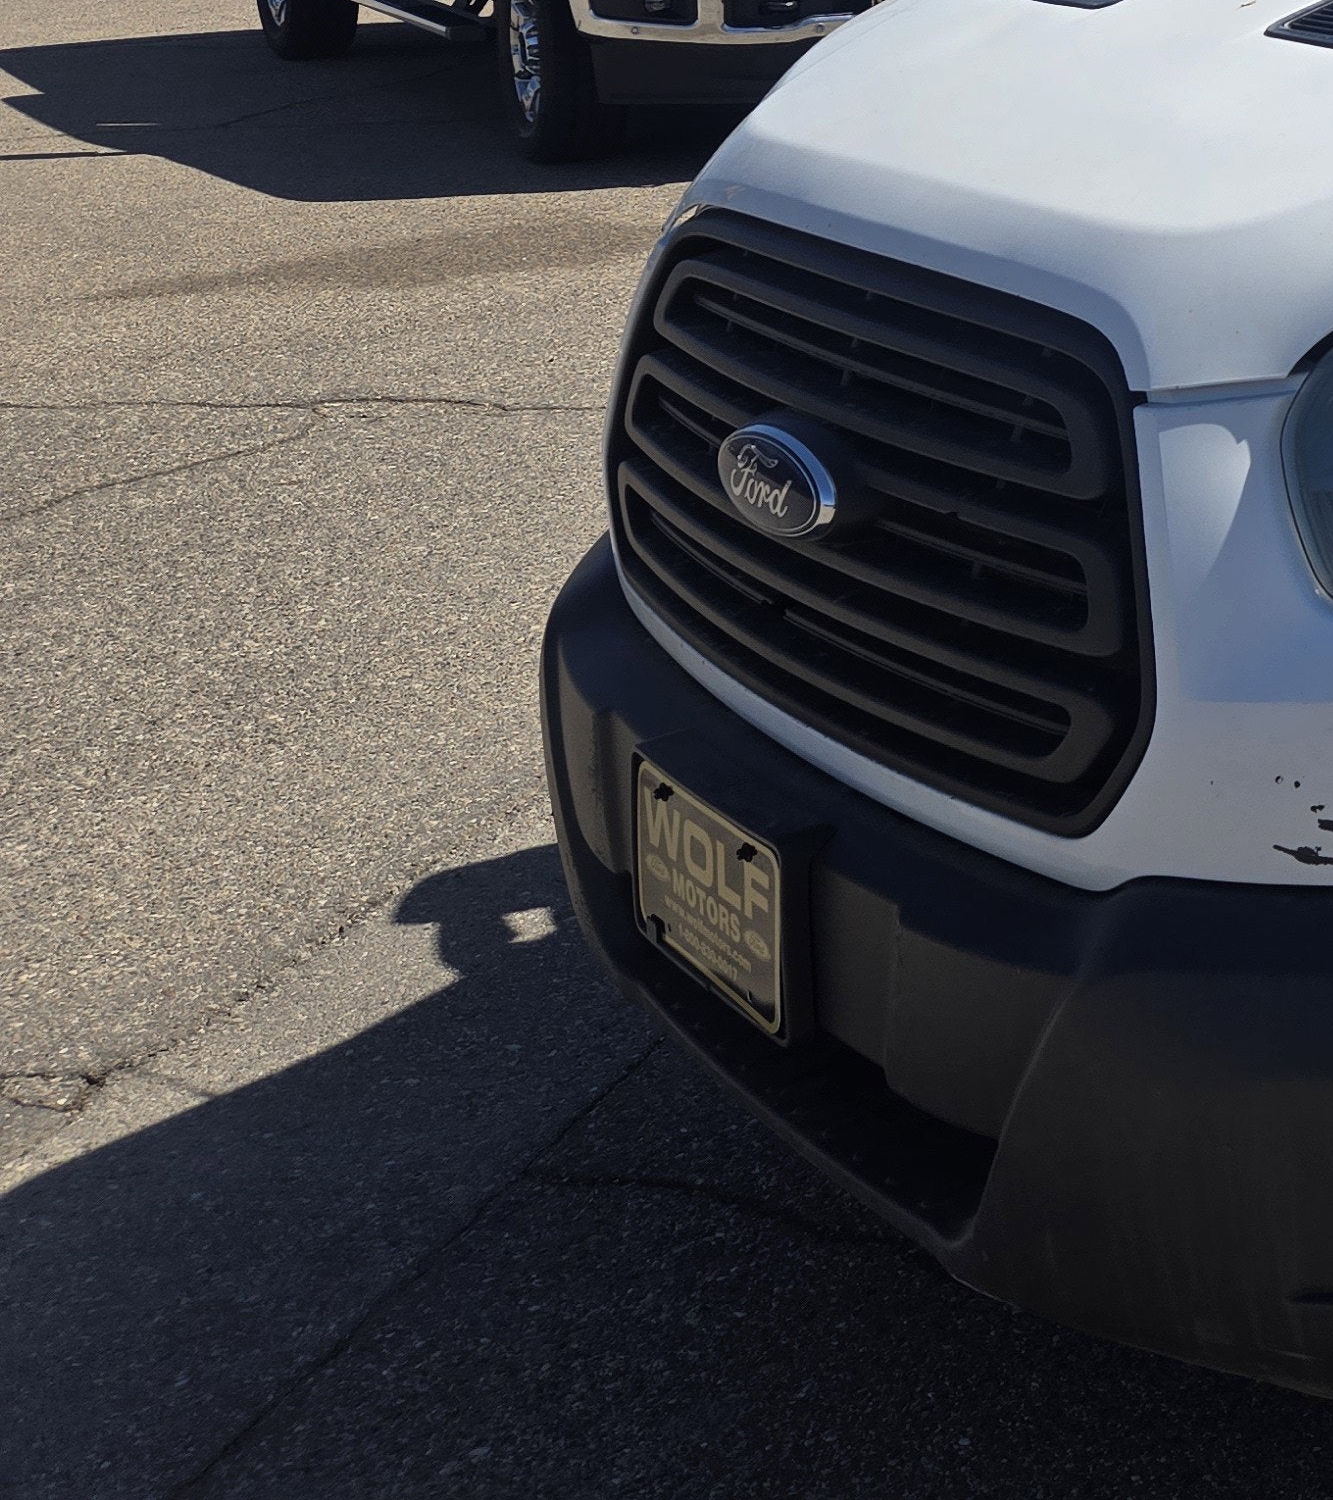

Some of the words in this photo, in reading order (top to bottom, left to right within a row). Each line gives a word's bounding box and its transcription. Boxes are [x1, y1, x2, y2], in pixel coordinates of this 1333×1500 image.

[730, 443, 792, 518] Ford
[643, 785, 770, 920] WOLF
[671, 867, 742, 943] MOTORS
